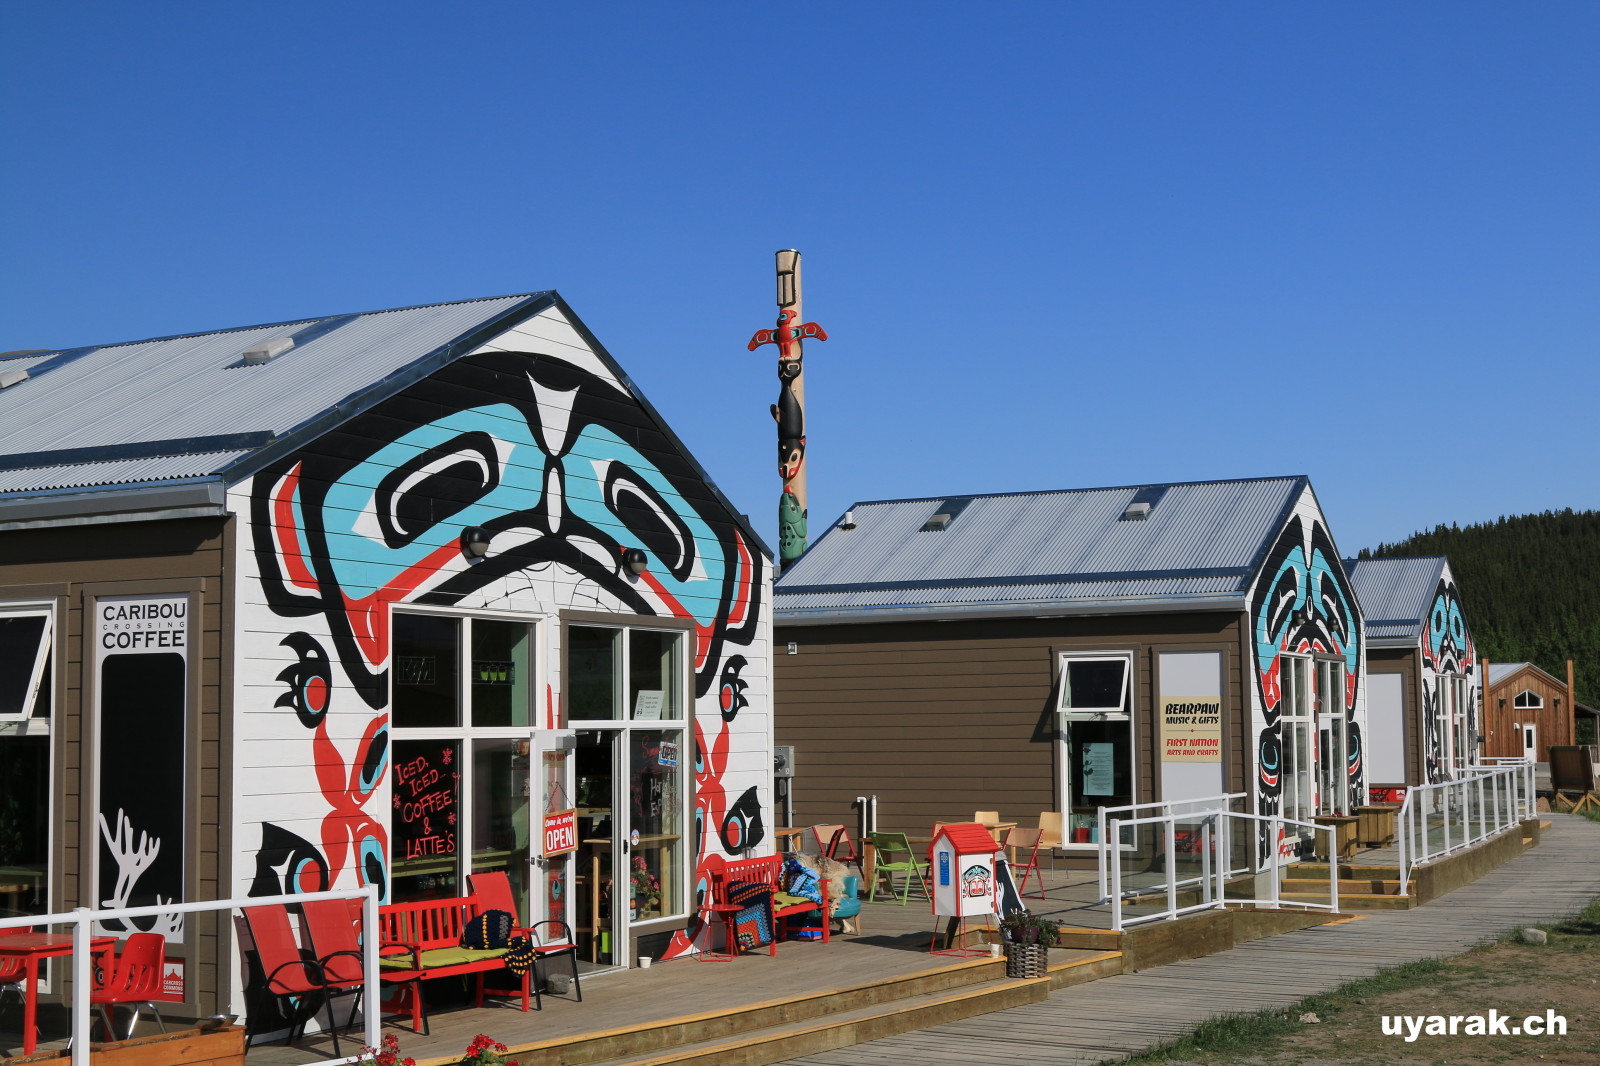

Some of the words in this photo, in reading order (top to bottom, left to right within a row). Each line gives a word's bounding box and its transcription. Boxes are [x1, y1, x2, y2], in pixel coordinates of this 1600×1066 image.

[103, 603, 186, 621] CARIBOU
[102, 621, 185, 630] CROSSING
[102, 630, 185, 649] COFFEE
[1165, 703, 1219, 714] BEARPAW
[1166, 716, 1190, 724] MUSIC
[1191, 716, 1197, 724] &
[1198, 716, 1219, 724] GIFTS
[1166, 738, 1188, 747] FIRST
[1189, 738, 1219, 747] NATION
[423, 816, 432, 835] &
[546, 826, 574, 851] OPEN
